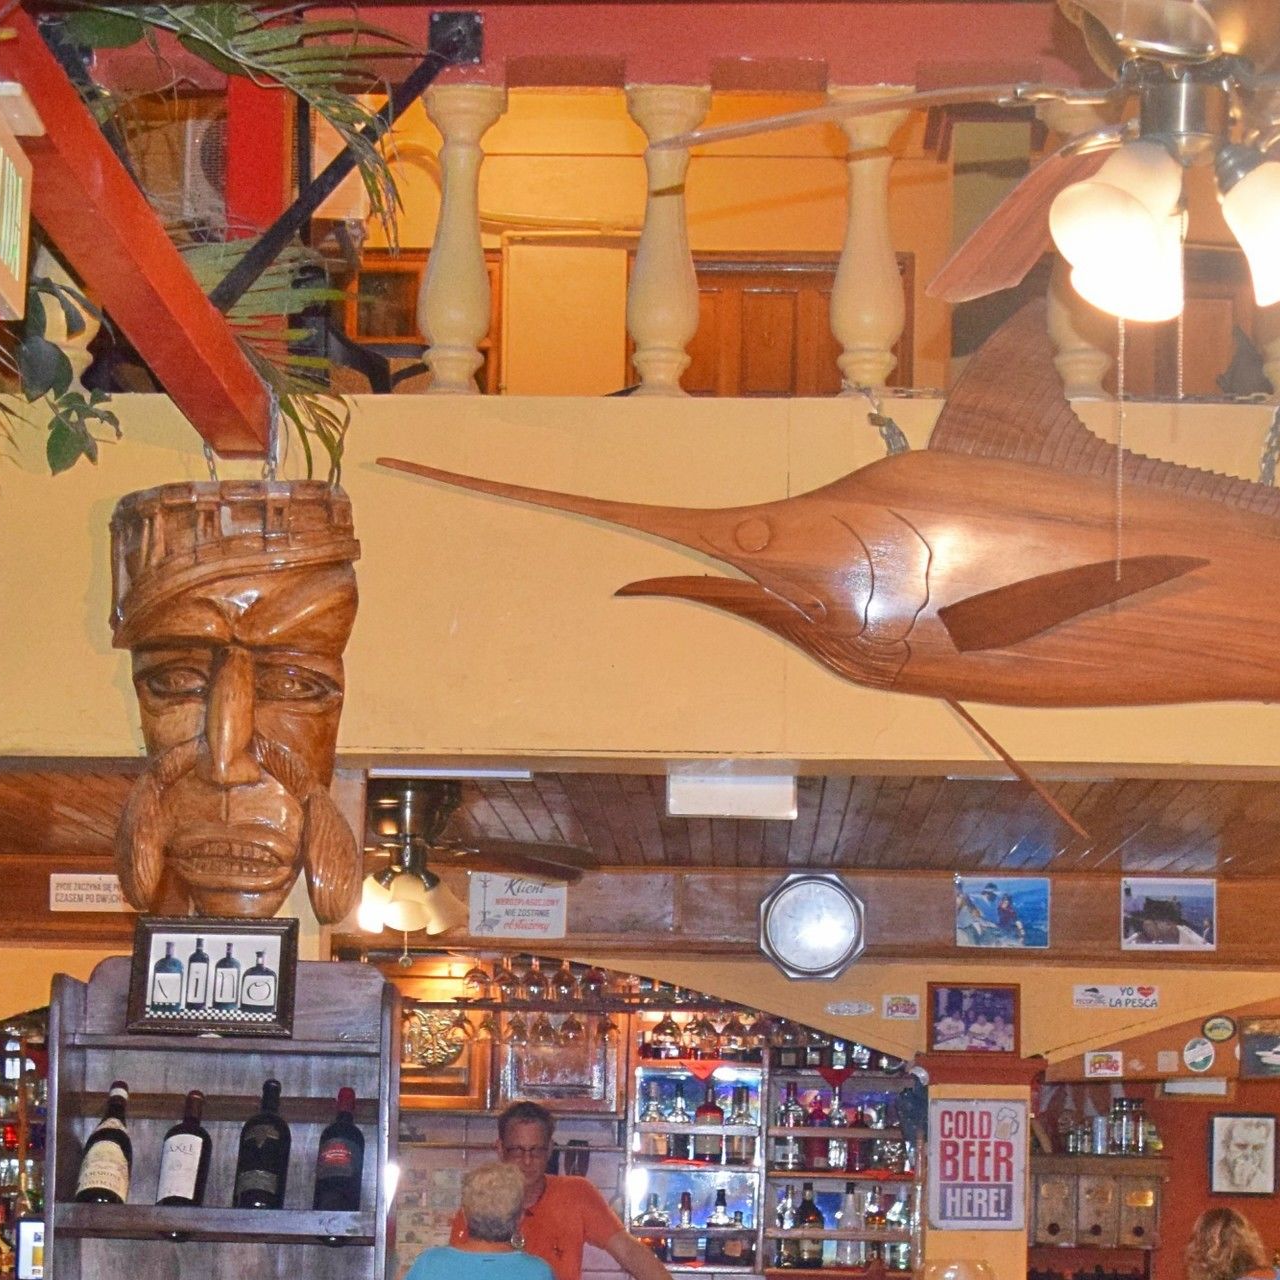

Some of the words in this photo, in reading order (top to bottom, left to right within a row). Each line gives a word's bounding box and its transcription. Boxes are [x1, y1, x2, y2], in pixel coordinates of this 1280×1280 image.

[504, 878, 545, 896] Klient
[55, 893, 83, 903] CZASEM
[85, 894, 95, 903] PO
[1119, 986, 1135, 997] YO
[1109, 998, 1122, 1008] LA
[1125, 998, 1158, 1008] PESCA
[939, 1110, 992, 1139] COLD
[939, 1141, 1013, 1182] BEER
[945, 1187, 1007, 1218] HERE!
